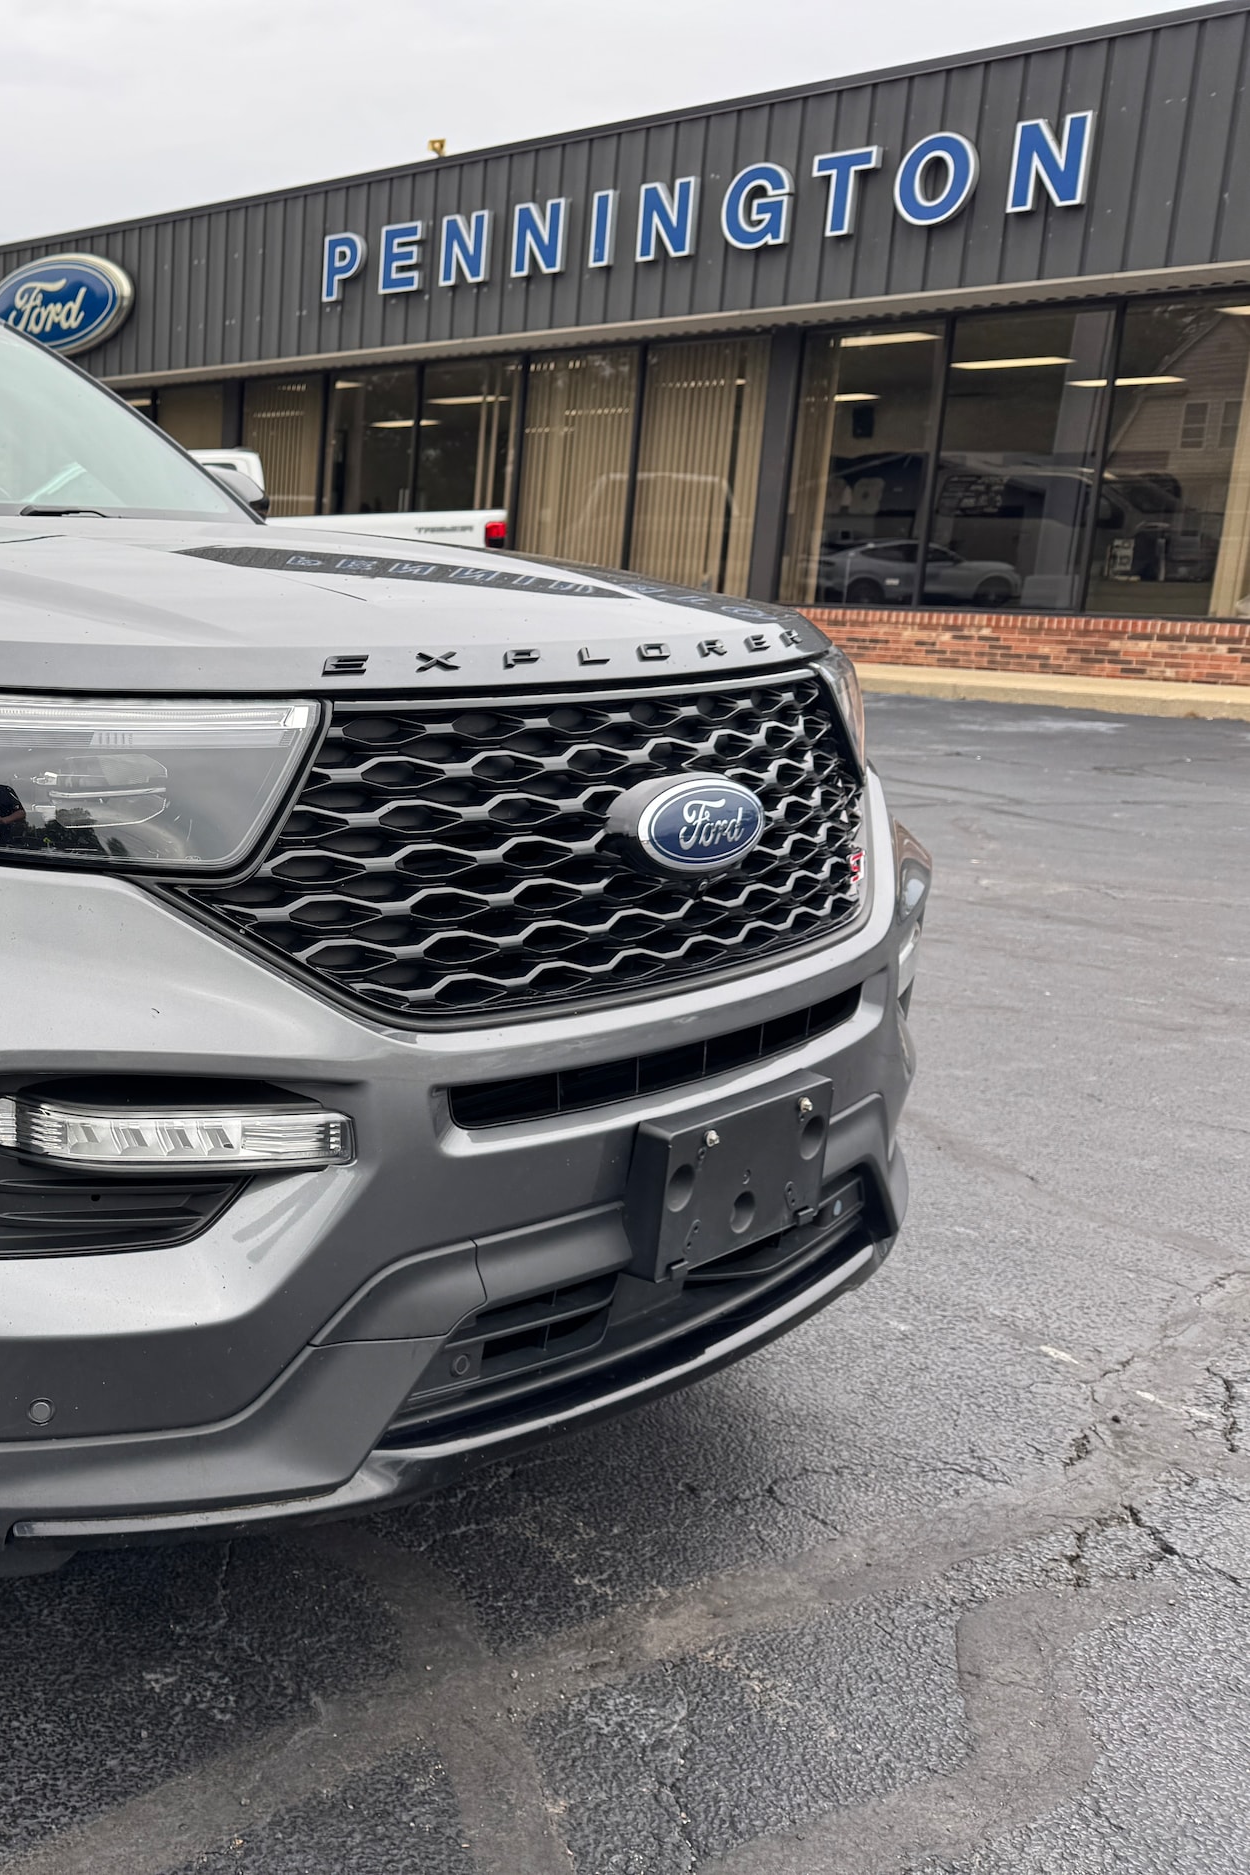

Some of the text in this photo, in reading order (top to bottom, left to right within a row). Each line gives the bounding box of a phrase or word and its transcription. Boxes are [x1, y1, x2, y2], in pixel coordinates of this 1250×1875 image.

[321, 110, 1096, 302] PENNINGTON
[7, 277, 87, 334] Ford
[321, 628, 804, 676] EXPLORER
[678, 798, 744, 850] Ford
